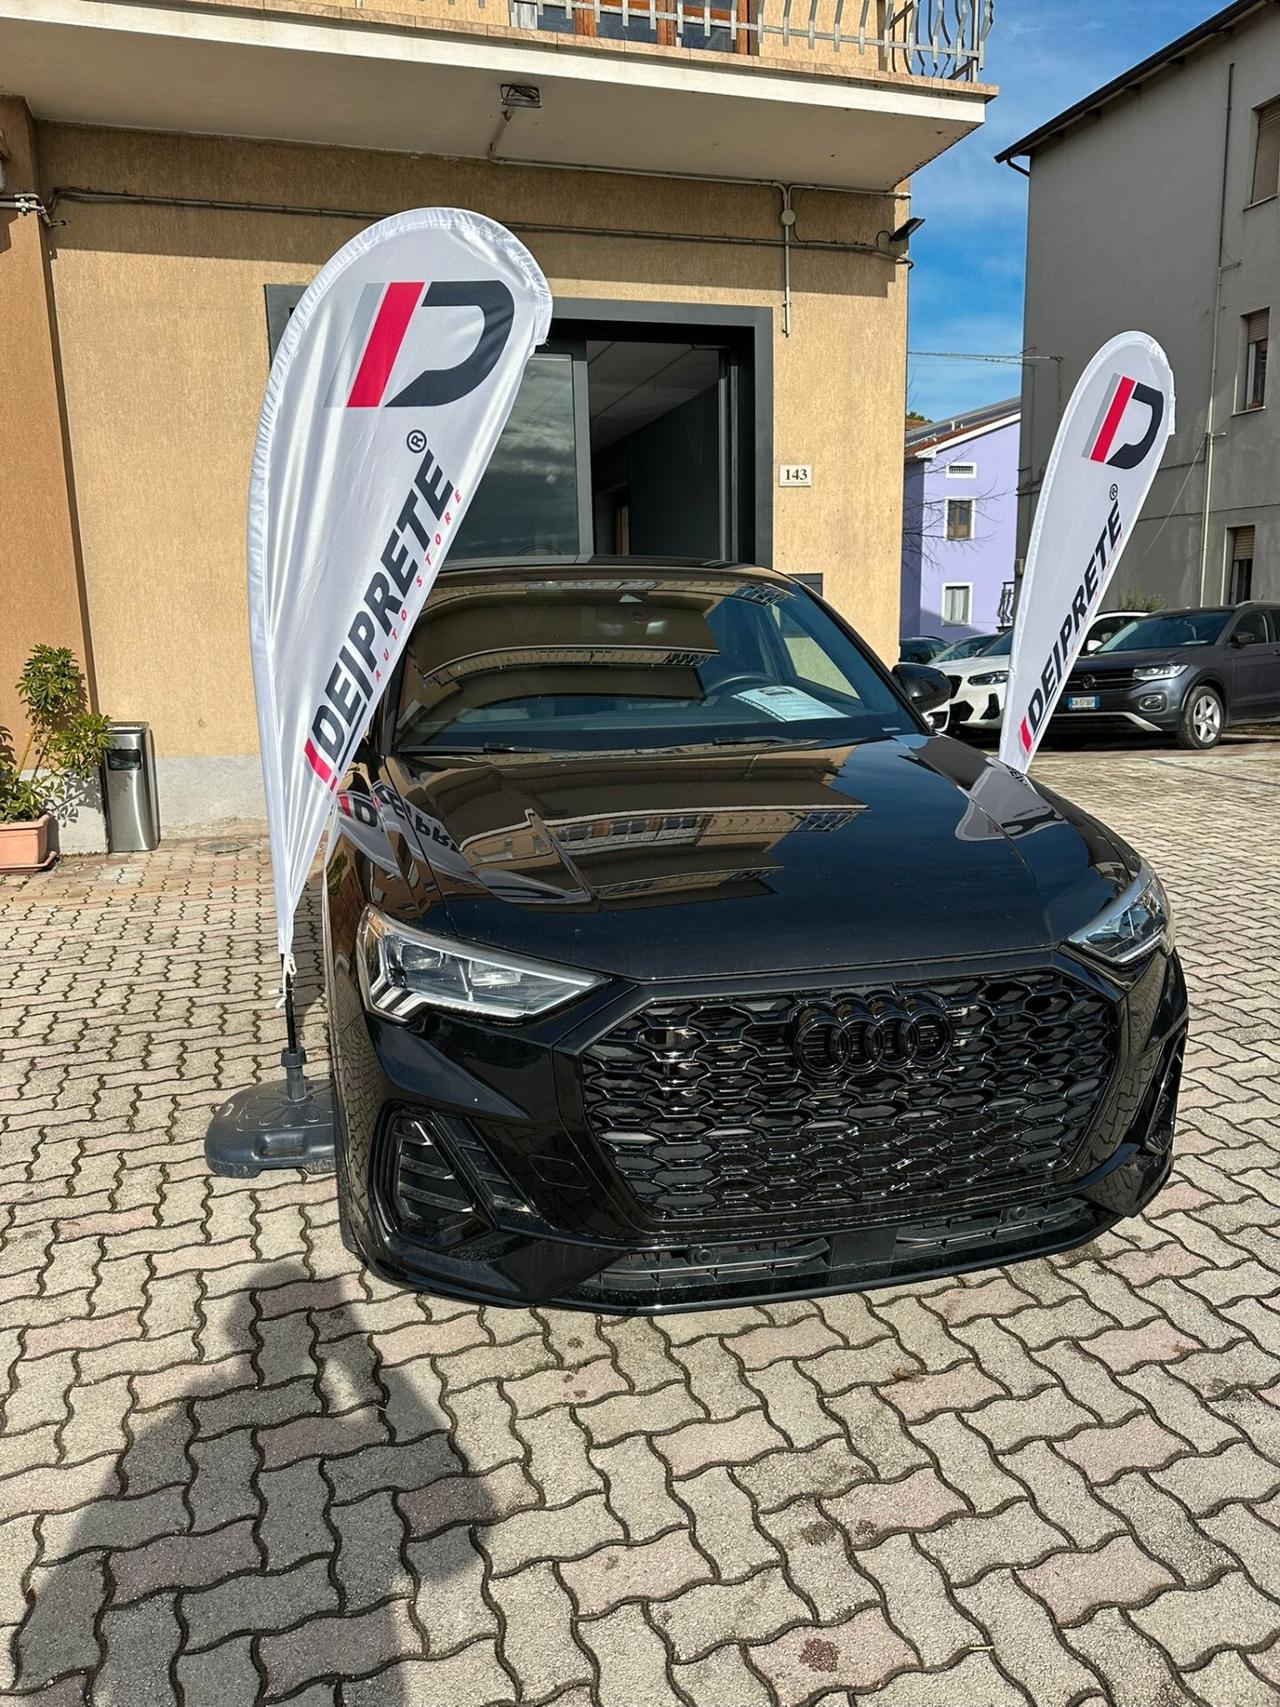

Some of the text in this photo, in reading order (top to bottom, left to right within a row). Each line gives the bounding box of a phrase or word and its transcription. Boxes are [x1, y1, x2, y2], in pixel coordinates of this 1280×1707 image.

[784, 468, 808, 481] 143
[374, 487, 463, 682] AUTO STORE
